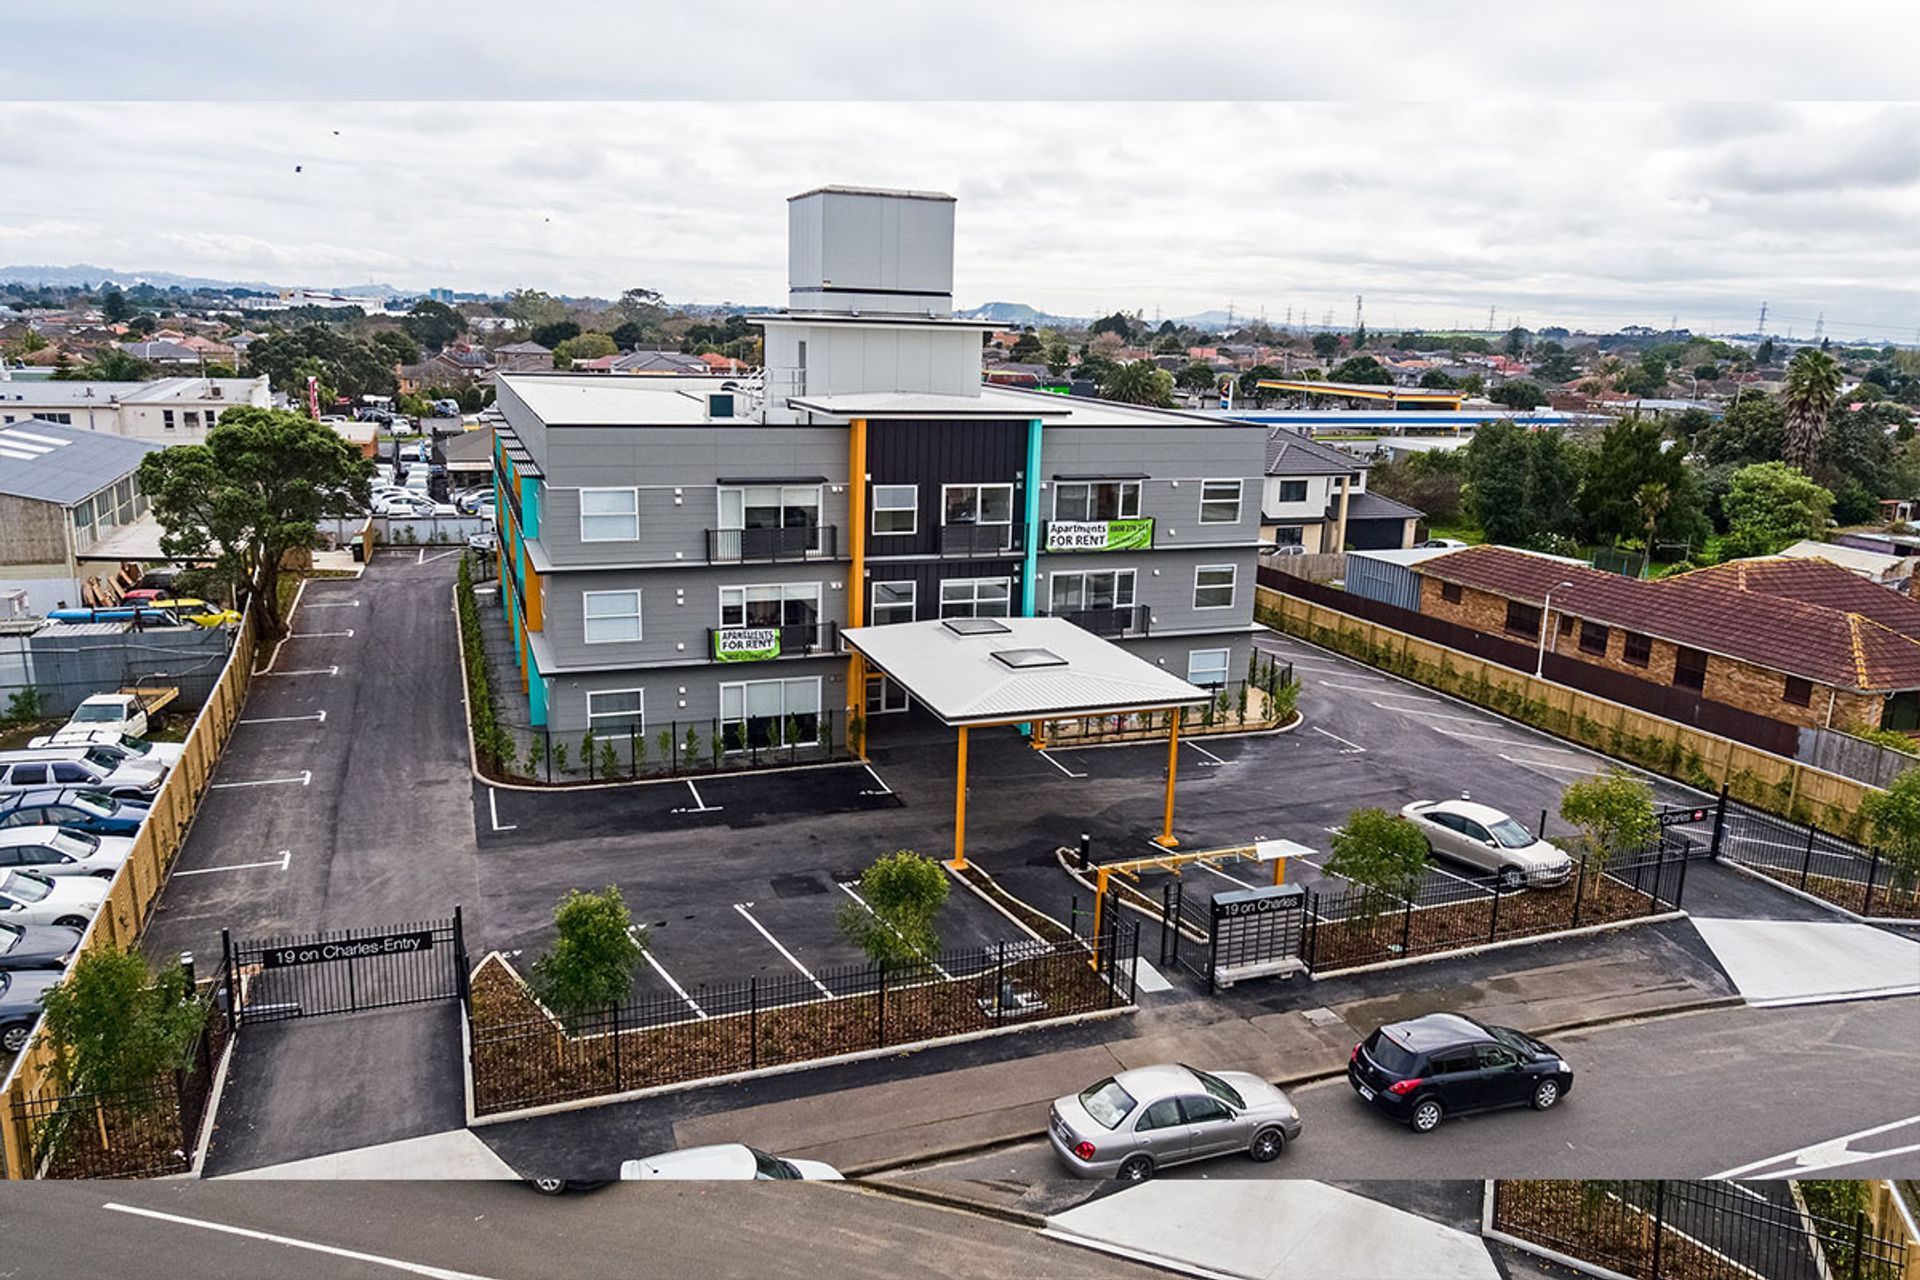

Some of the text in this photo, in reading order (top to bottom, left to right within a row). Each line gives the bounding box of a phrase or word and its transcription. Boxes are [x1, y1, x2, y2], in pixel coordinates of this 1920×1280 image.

[1050, 524, 1106, 534] Apartments
[1049, 535, 1105, 546] FOR RENT
[723, 640, 771, 650] FOR RENT
[1225, 897, 1298, 916] 19 on Charles
[275, 937, 421, 964] 19 on Charles-Entry
